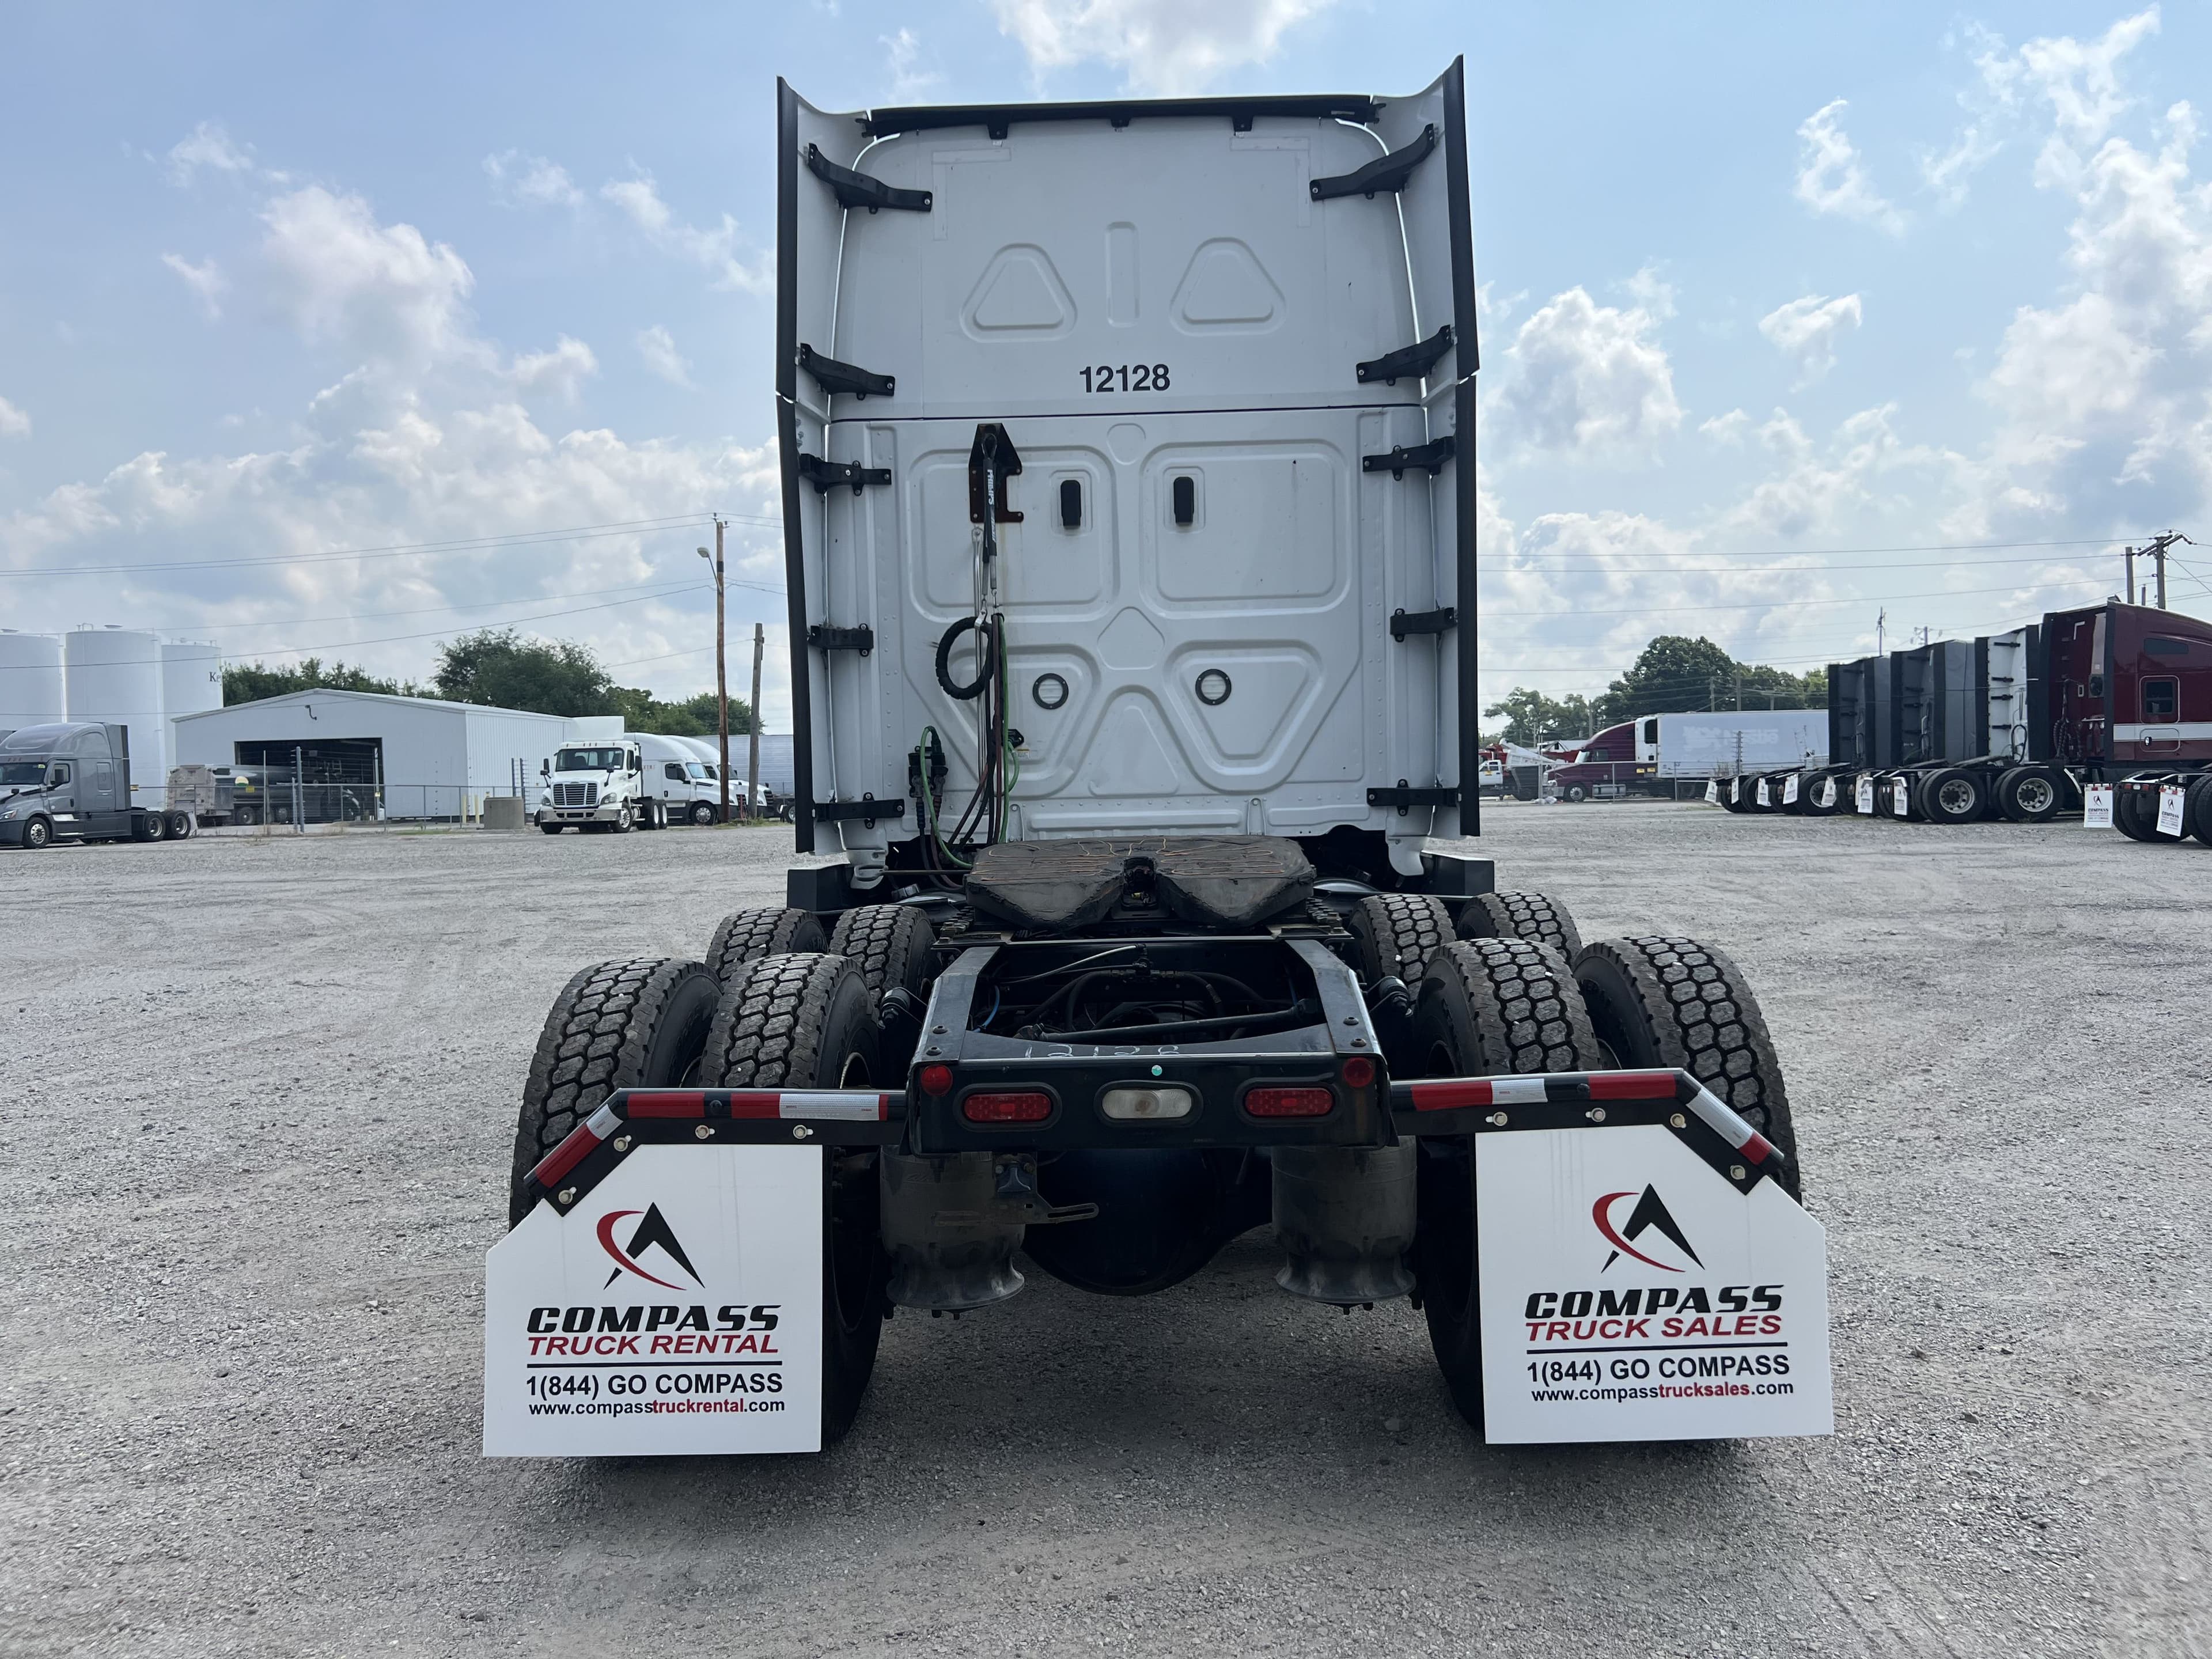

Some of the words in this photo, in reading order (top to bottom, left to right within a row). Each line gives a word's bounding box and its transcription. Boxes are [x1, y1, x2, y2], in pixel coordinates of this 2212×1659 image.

[1080, 364, 1170, 393] 12128
[1525, 1285, 1783, 1319] COMPASS
[527, 1305, 781, 1333] COMPASS
[1526, 1319, 1650, 1341] TRUCK
[1661, 1315, 1781, 1337] SALES
[528, 1336, 641, 1355] TRUCK
[650, 1335, 778, 1354] RENTAL
[1528, 1360, 1601, 1387] 1(844)
[1611, 1359, 1649, 1379] GO
[1659, 1355, 1789, 1378] COMPASS
[527, 1375, 599, 1401] 1(844)
[608, 1375, 646, 1395] GO
[656, 1373, 782, 1393] COMPASS
[1532, 1381, 1793, 1403] www.compasstrucksales.com
[529, 1398, 784, 1417] www.compasstruckrental.com
